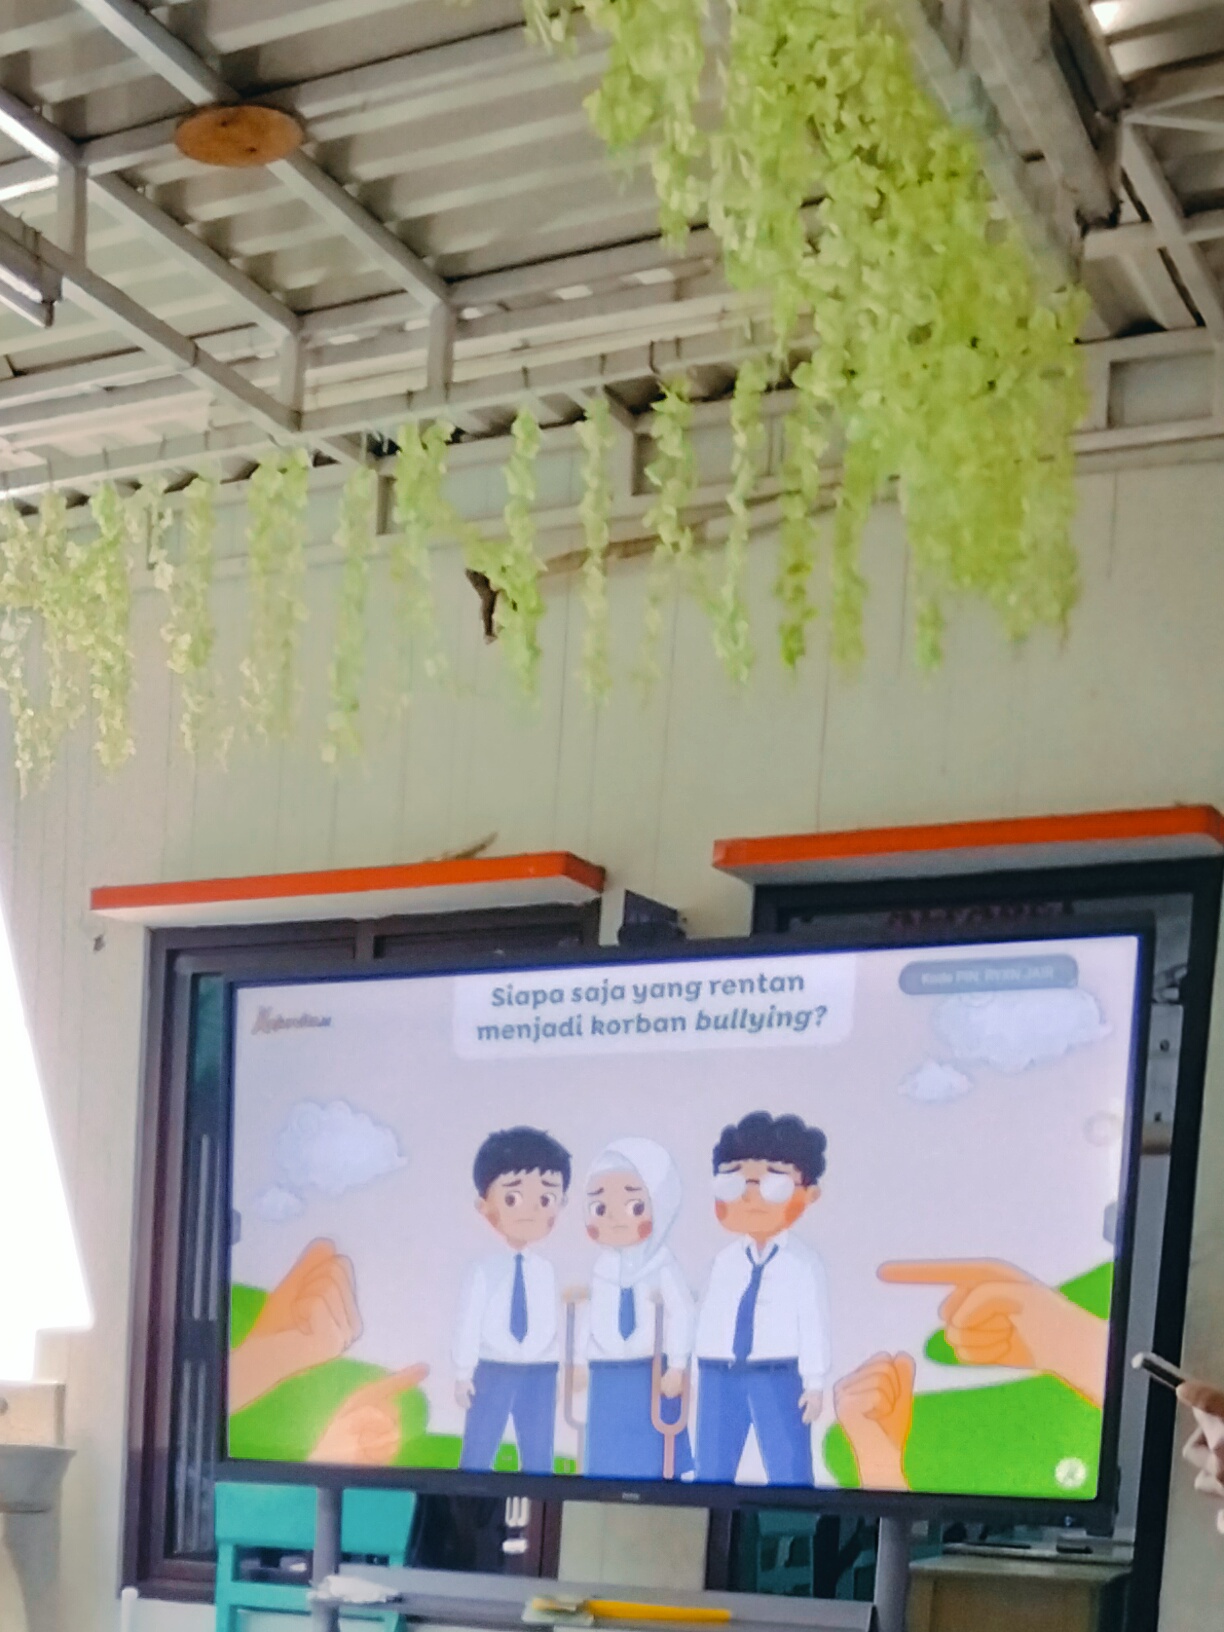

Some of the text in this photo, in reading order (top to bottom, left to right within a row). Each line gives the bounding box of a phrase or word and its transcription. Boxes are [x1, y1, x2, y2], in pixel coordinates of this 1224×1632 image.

[491, 973, 805, 1010] Siapa saja yang rentan
[477, 1004, 828, 1043] menjadi korban bullying?
